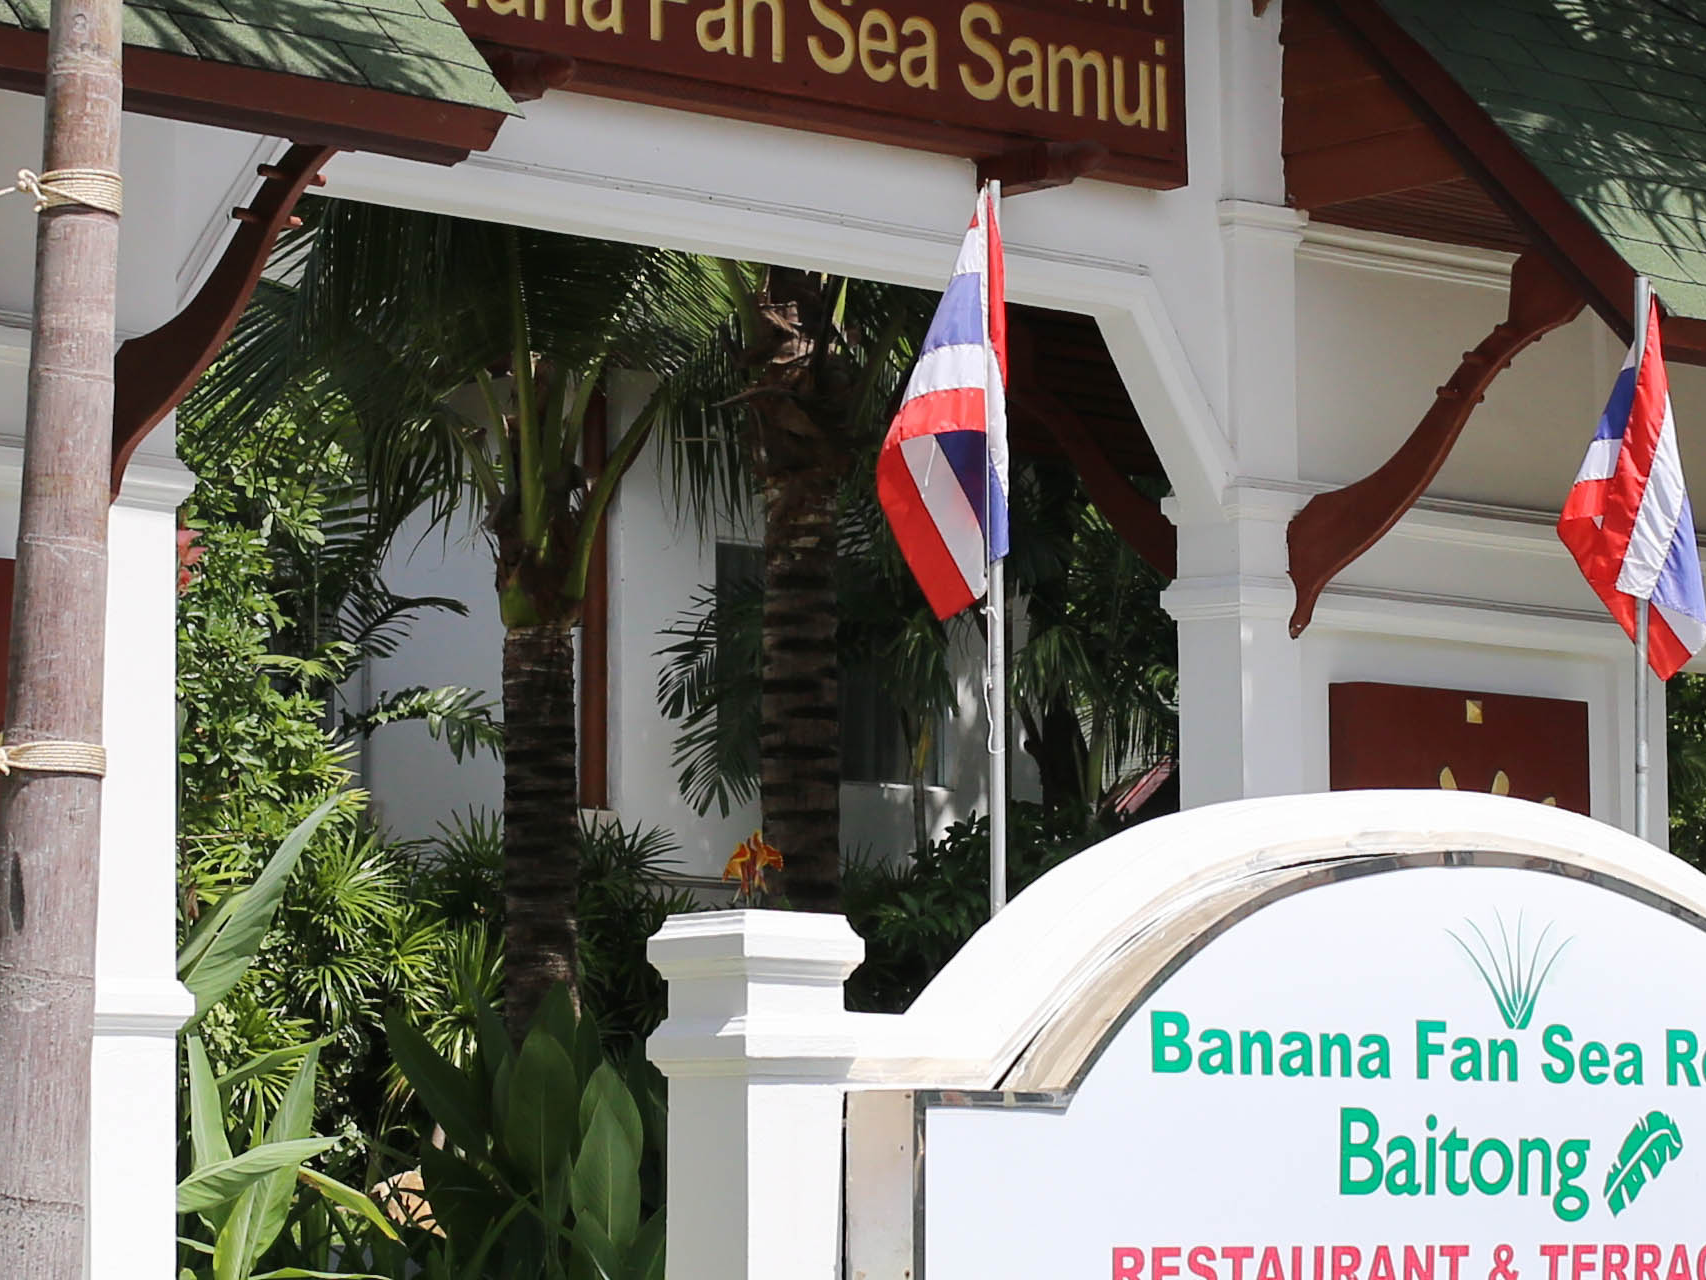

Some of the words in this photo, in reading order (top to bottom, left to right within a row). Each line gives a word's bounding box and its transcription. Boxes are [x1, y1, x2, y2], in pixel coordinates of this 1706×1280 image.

[959, 4, 1166, 131] Samui
[1150, 1010, 1391, 1080] Banana
[1416, 1019, 1519, 1083] Fan
[1541, 1023, 1644, 1086] Sea
[1339, 1107, 1591, 1223] Baitong
